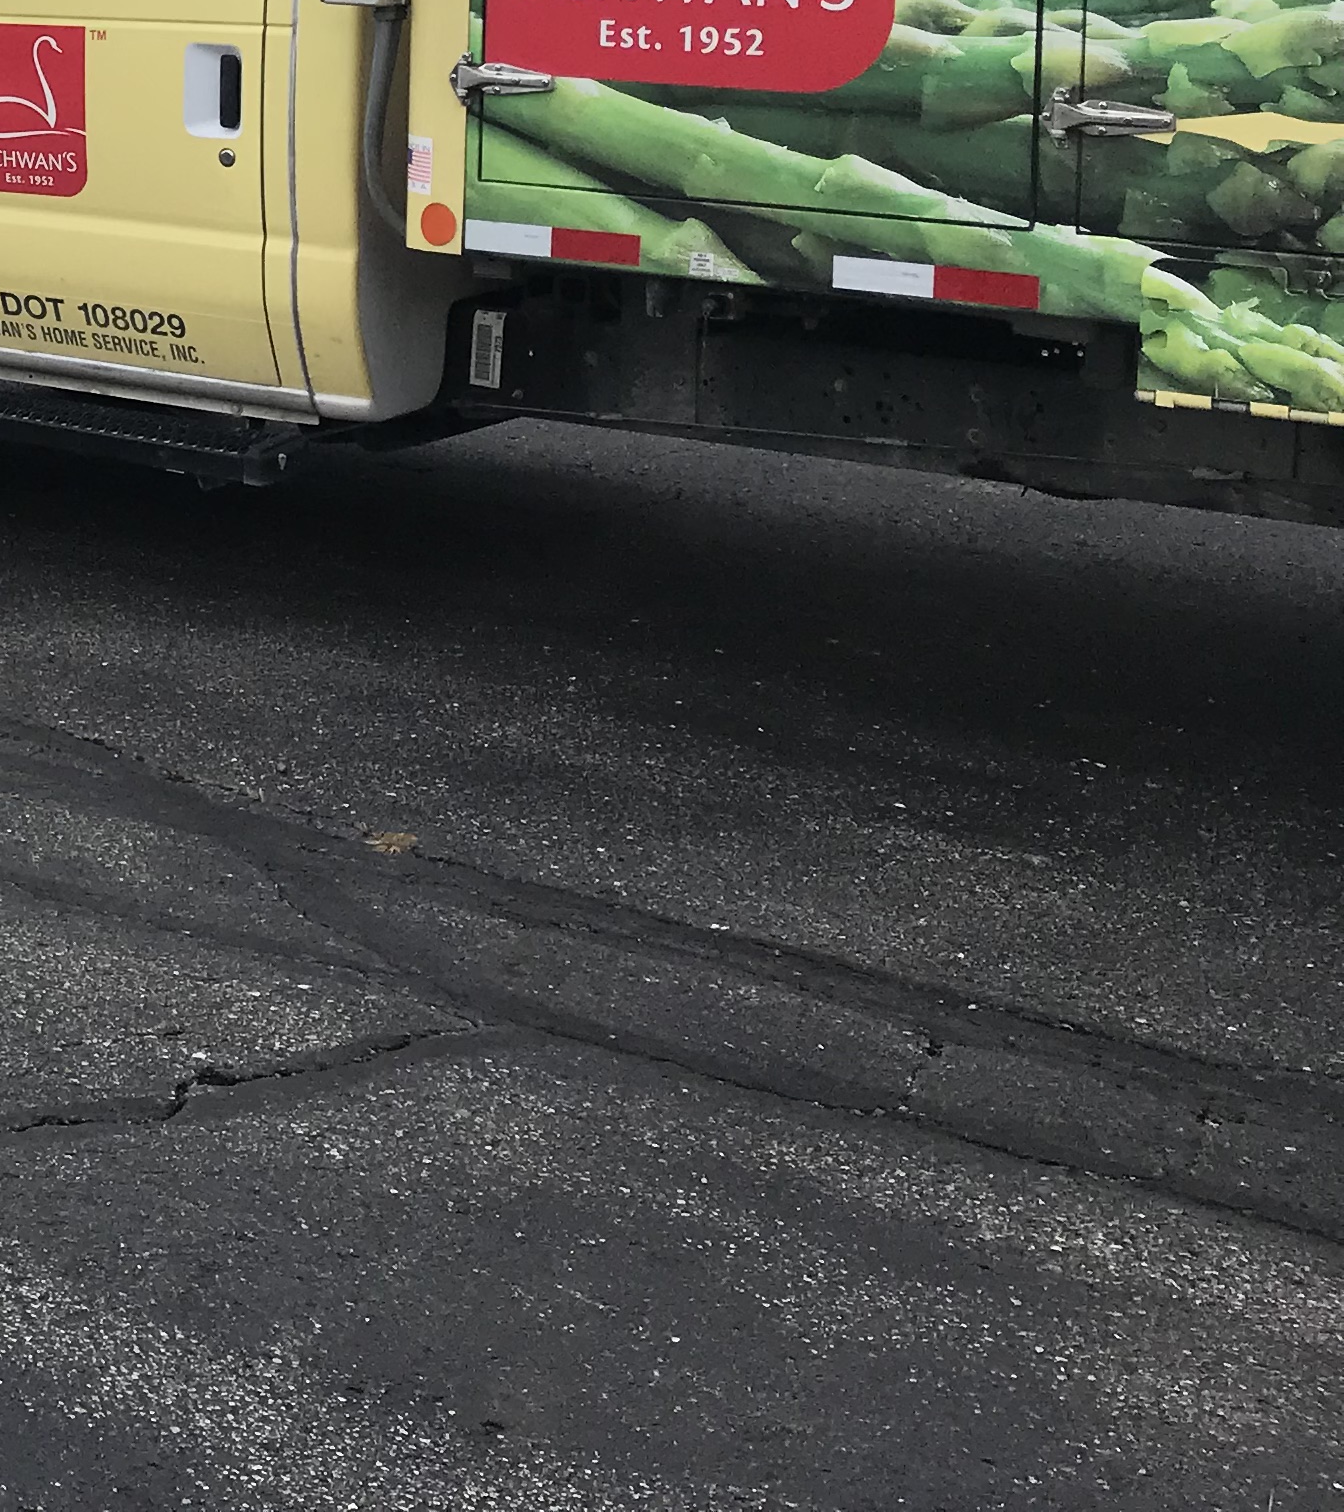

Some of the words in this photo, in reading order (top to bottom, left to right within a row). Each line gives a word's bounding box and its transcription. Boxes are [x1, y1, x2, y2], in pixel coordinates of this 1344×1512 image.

[89, 30, 107, 41] TM
[599, 19, 663, 50] Est.
[679, 25, 765, 56] 1952
[5, 172, 26, 184] Est.
[29, 175, 55, 186] 1952
[0, 291, 65, 322] DOT
[77, 302, 187, 339] 108029
[40, 326, 89, 348] HOME
[93, 333, 167, 362] SERVICE,
[169, 343, 206, 364] INC.
